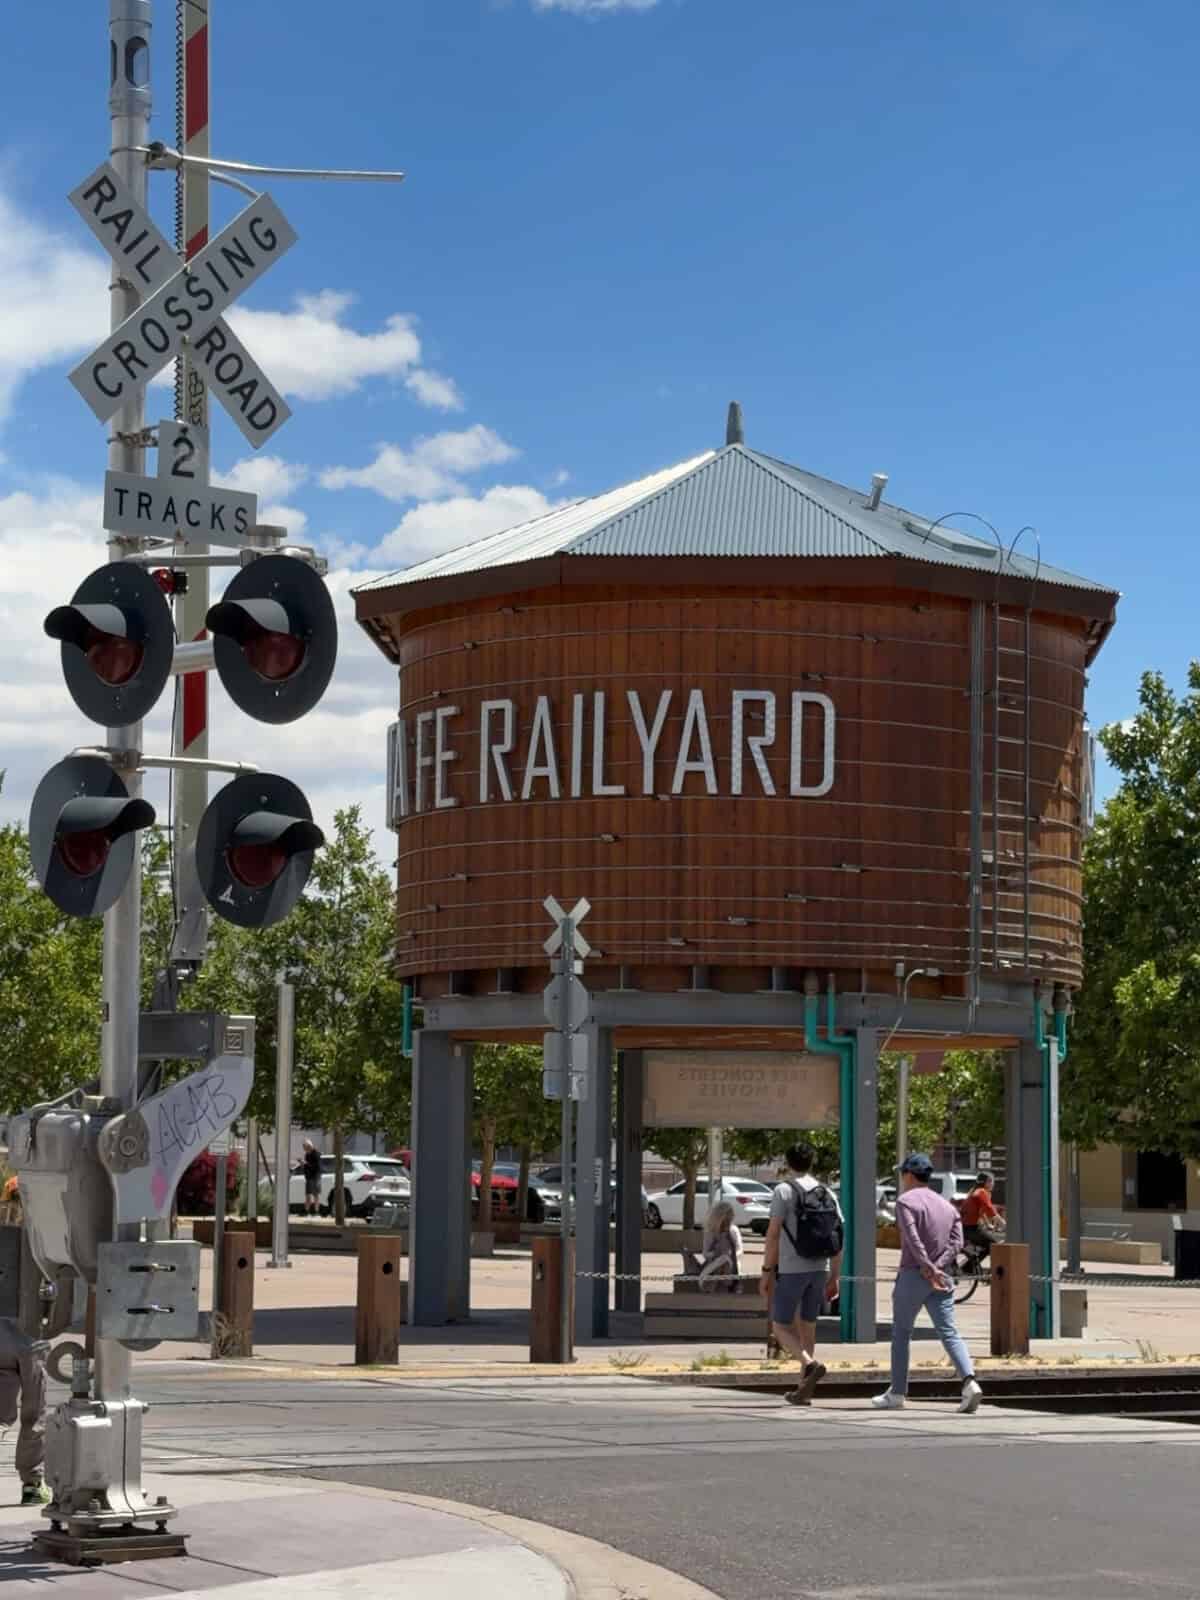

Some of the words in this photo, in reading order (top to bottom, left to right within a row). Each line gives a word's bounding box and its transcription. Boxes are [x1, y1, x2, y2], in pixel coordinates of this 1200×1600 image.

[83, 175, 162, 285] RAIL
[194, 325, 278, 432] ROAD
[92, 216, 278, 399] CROSSING
[113, 487, 250, 535] TRACKS
[171, 435, 196, 479] 2
[479, 688, 836, 803] RAILYARD
